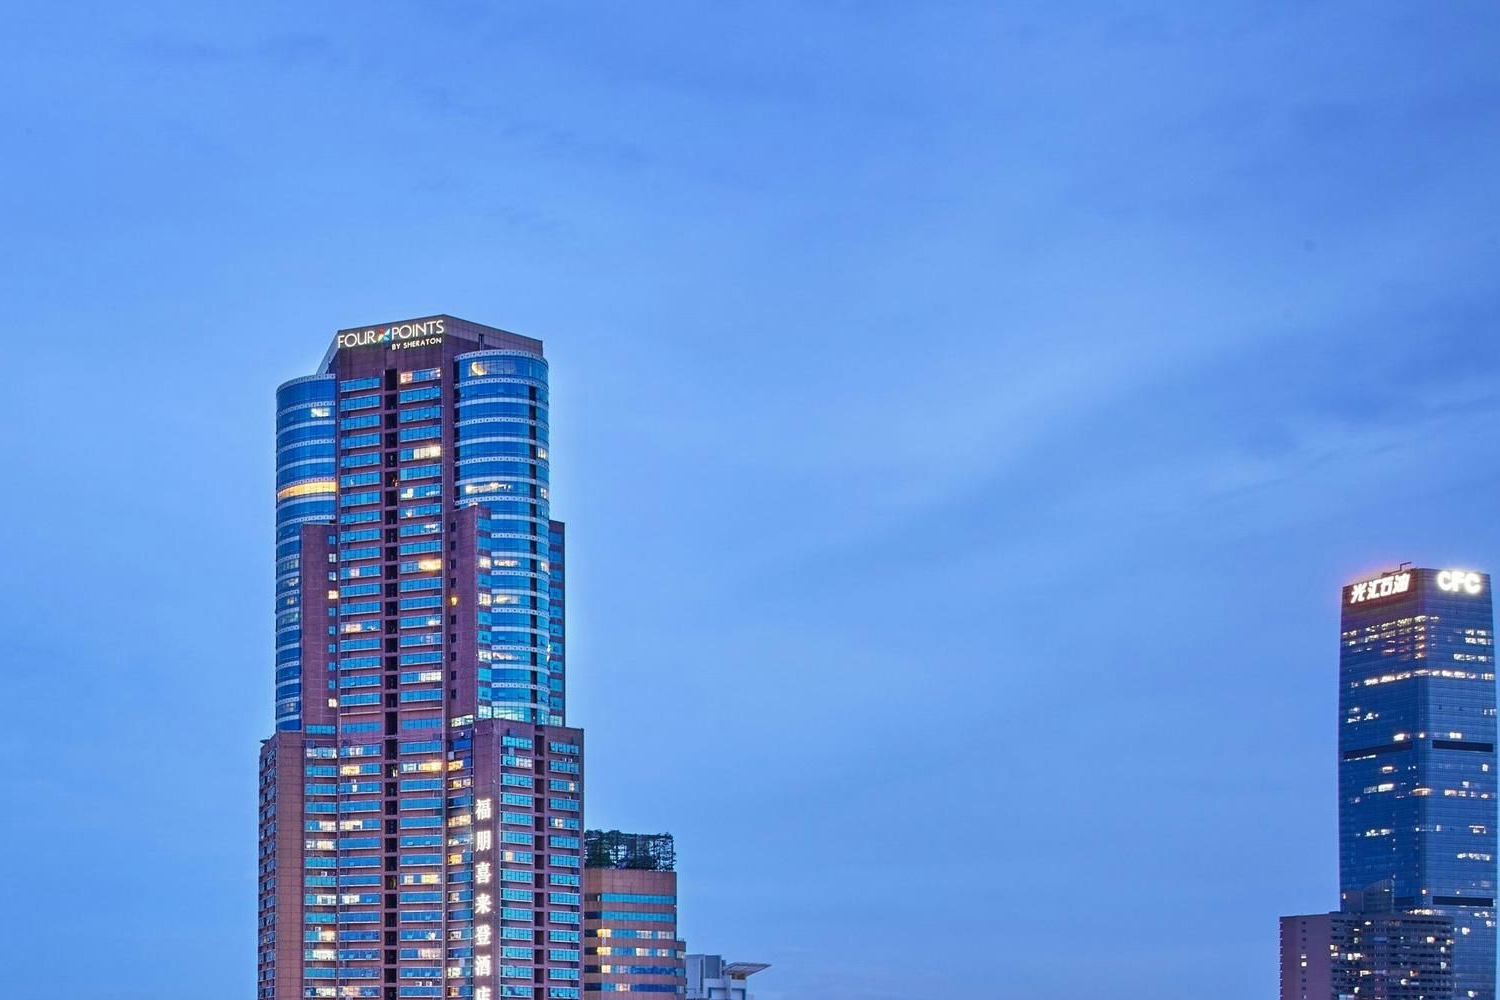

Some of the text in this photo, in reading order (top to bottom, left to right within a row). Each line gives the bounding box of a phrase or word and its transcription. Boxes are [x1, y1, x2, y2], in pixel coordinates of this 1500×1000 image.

[338, 320, 445, 348] FOUR POINTS
[391, 337, 442, 351] BY SHERATON
[1350, 573, 1411, 604] 光汇石油
[1437, 570, 1482, 595] CFC
